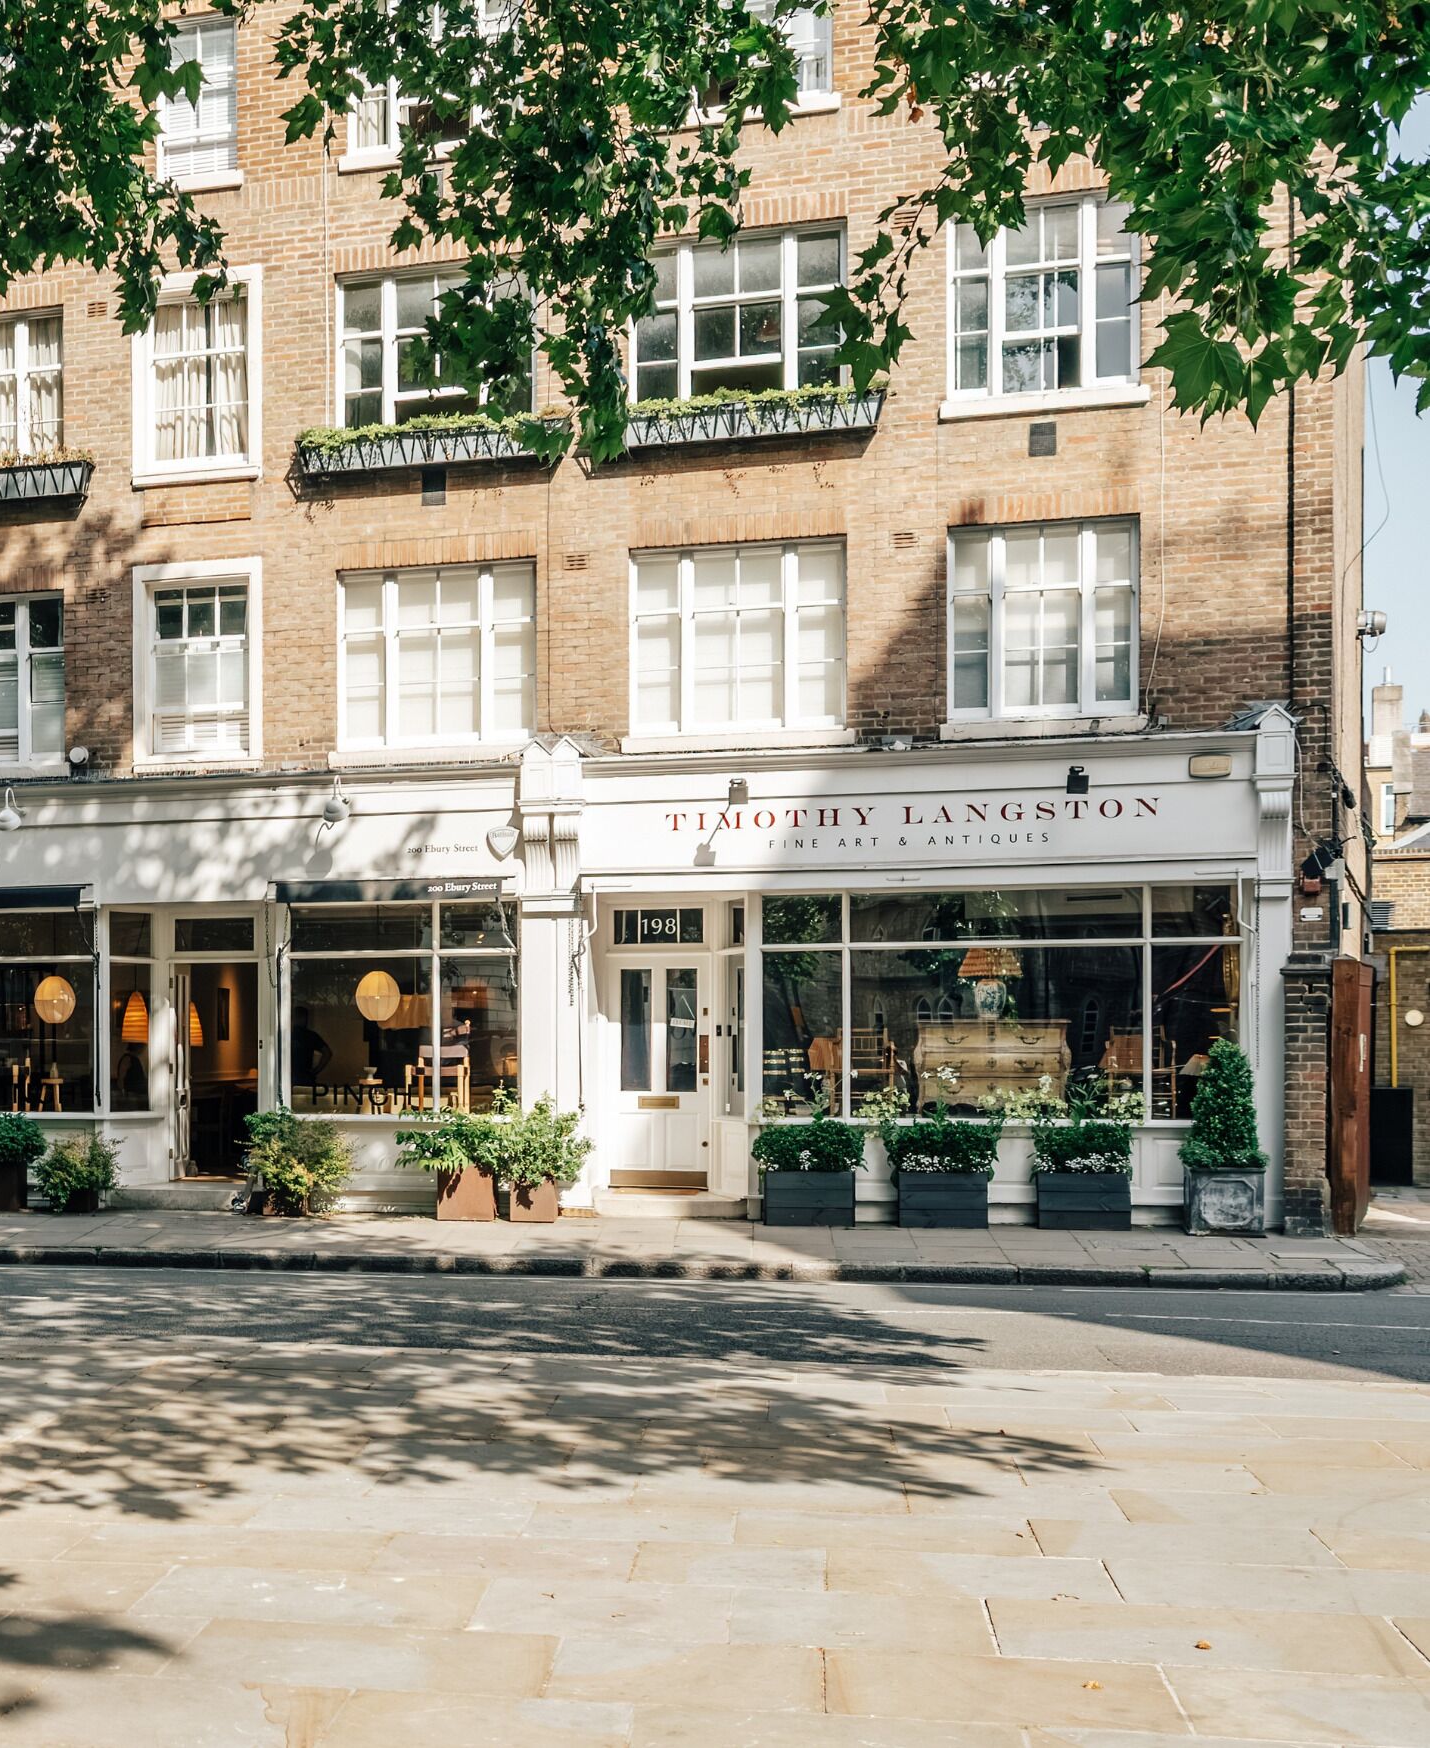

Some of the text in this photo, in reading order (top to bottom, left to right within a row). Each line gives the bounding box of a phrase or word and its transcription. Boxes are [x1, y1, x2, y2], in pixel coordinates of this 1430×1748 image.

[665, 797, 1161, 832] TIMOTHY LANGSTON
[425, 844, 451, 854] Ebury
[453, 843, 479, 853] Street
[769, 832, 1049, 849] FINE ART & ANTIQUES
[427, 881, 498, 893] 200 Ebury Street
[641, 917, 677, 935] 198
[312, 1084, 412, 1106] PINCH
